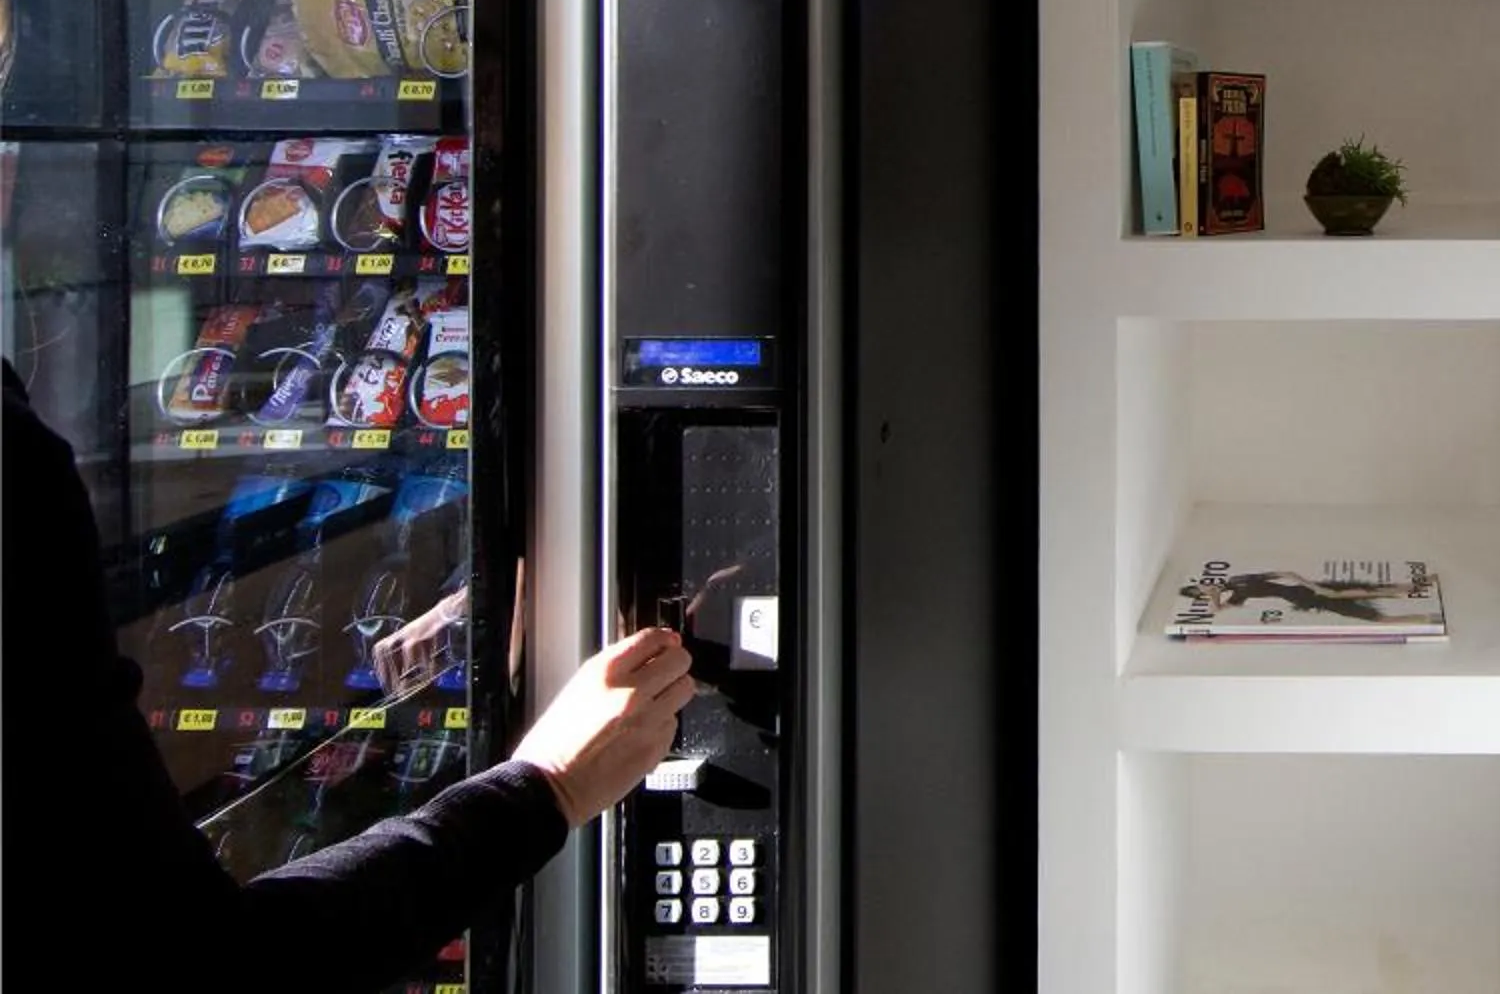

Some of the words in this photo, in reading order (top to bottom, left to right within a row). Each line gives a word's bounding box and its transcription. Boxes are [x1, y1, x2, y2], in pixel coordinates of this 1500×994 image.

[680, 367, 739, 385] Saeco
[663, 848, 671, 861] 1
[699, 847, 711, 861] 2
[738, 847, 749, 861] 3
[661, 877, 672, 890] 4
[700, 876, 711, 890] 5
[737, 876, 748, 891] 6
[661, 905, 673, 919] 7
[699, 905, 710, 919] 8
[737, 905, 748, 919] 9
